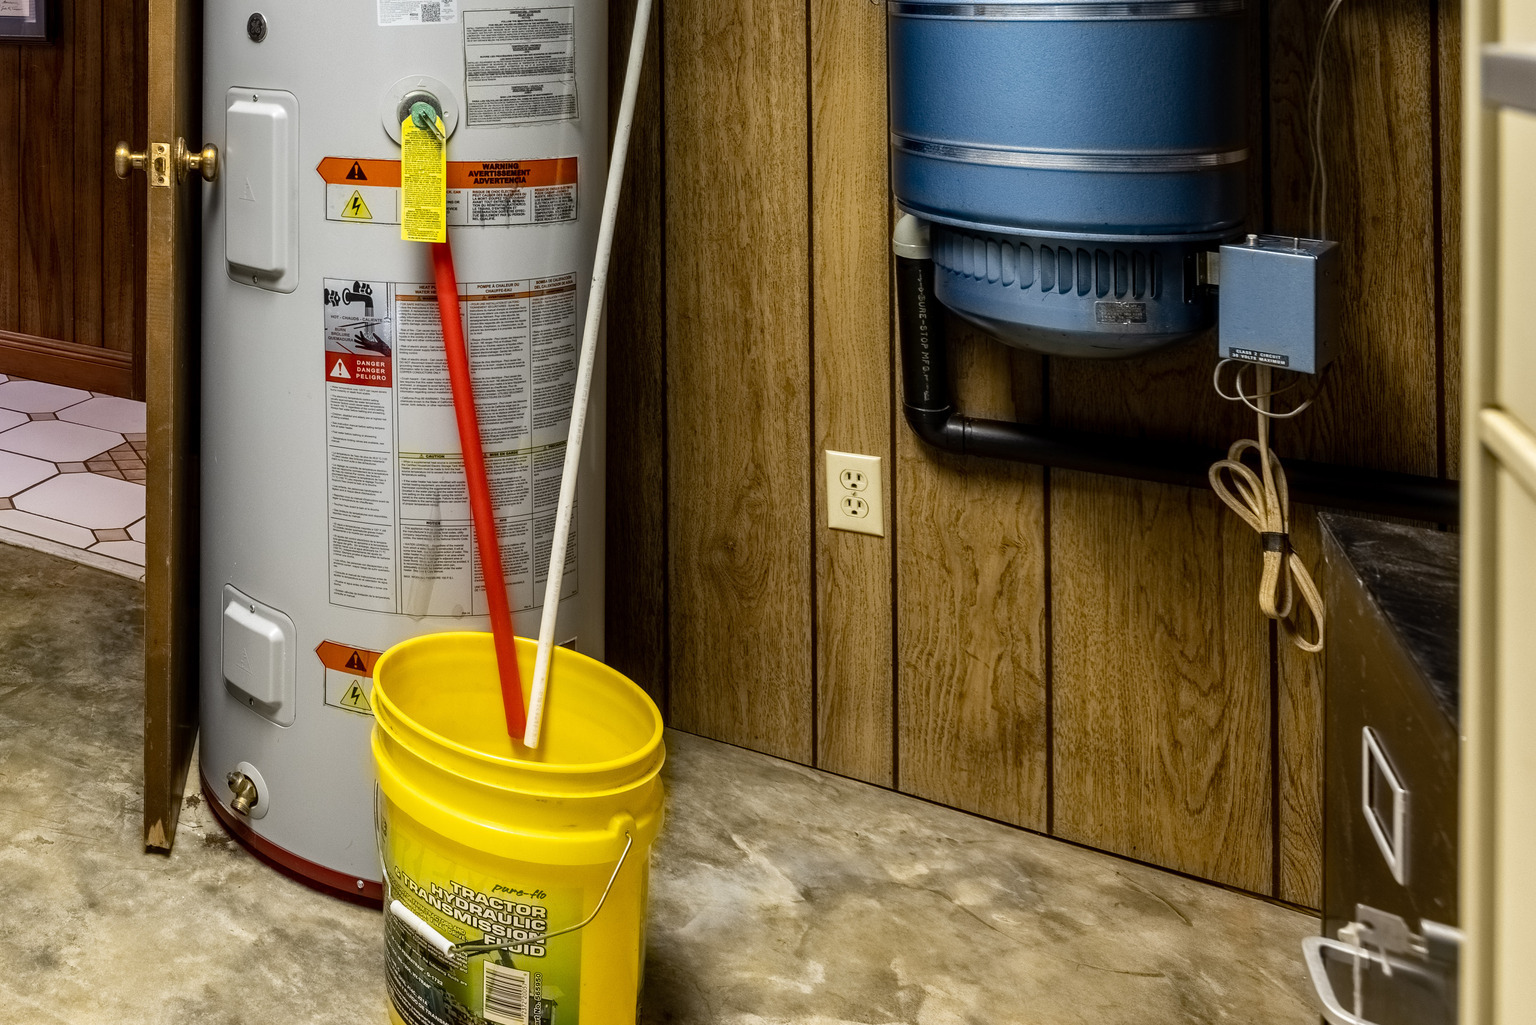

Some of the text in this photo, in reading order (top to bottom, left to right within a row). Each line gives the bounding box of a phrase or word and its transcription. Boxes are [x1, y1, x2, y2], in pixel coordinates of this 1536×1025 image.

[468, 169, 531, 177] AVERTISSEMENT
[357, 360, 385, 368] DANGER
[1258, 357, 1286, 365] MAXIMUM
[356, 373, 387, 381] PELIGRO
[492, 884, 547, 900] pure-flo
[450, 880, 547, 918] TRACTOR
[402, 871, 546, 943] TRANSMISSION
[431, 882, 547, 930] HYDRAULIC
